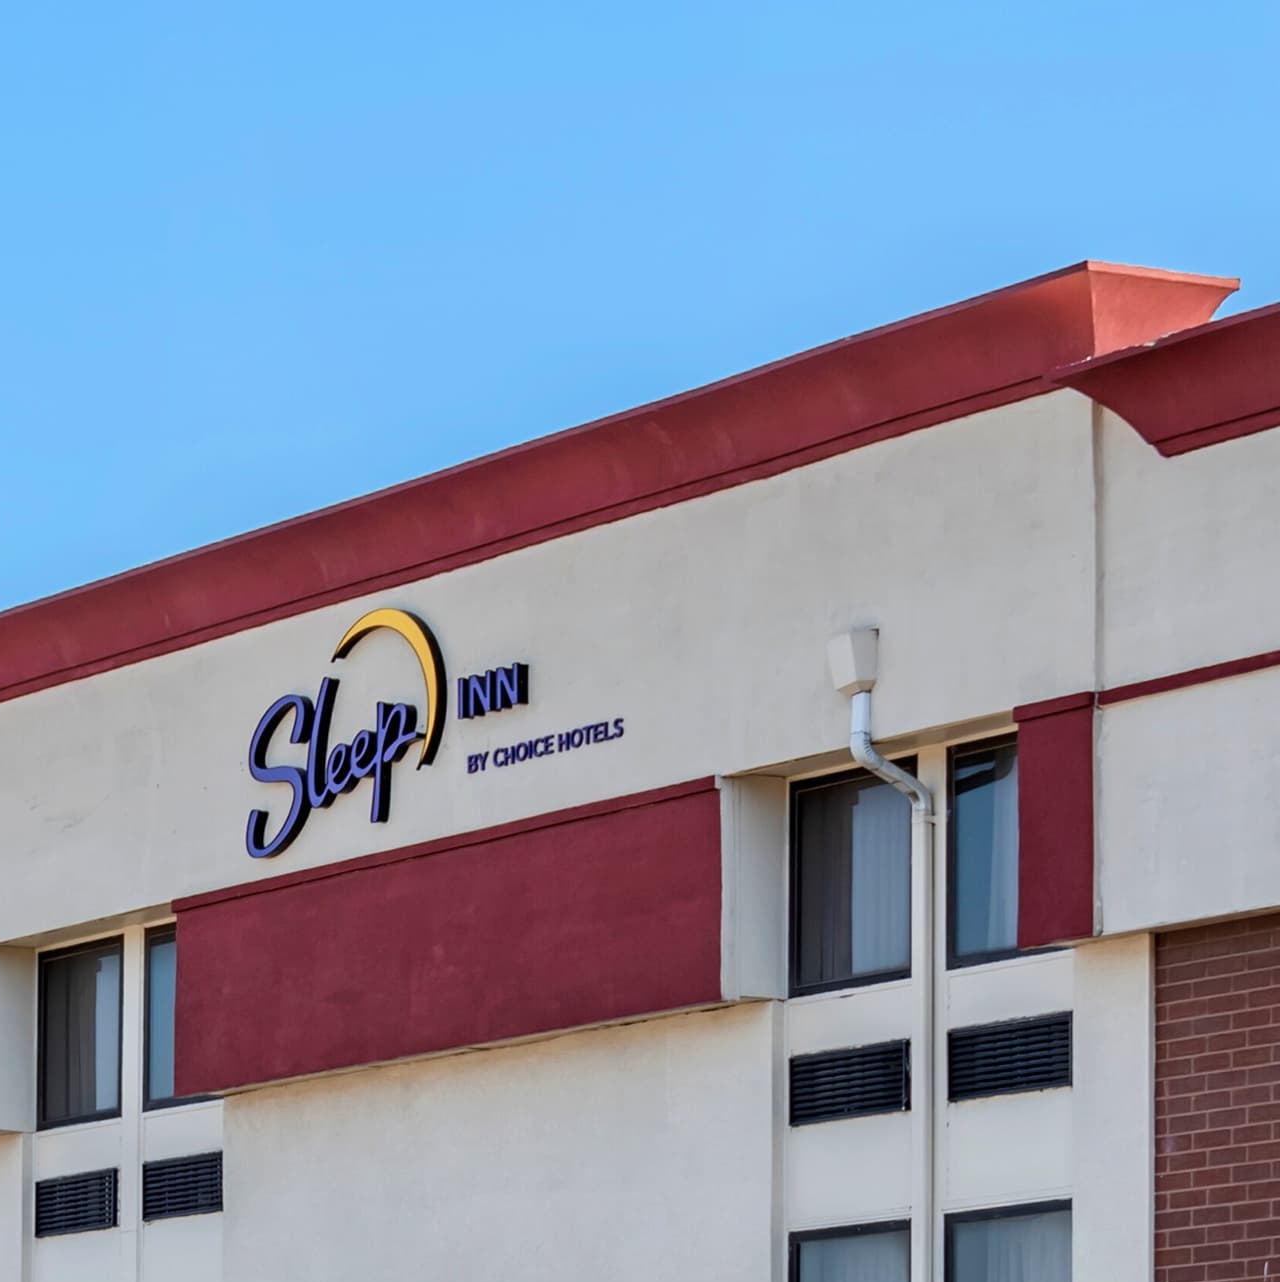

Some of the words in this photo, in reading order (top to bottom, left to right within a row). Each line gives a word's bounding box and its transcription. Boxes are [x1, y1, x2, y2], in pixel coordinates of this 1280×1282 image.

[246, 677, 422, 858] Sleep
[457, 662, 529, 719] INN
[467, 752, 489, 774] BY
[493, 735, 555, 767] CHOICE
[558, 718, 624, 752] HOTELS
